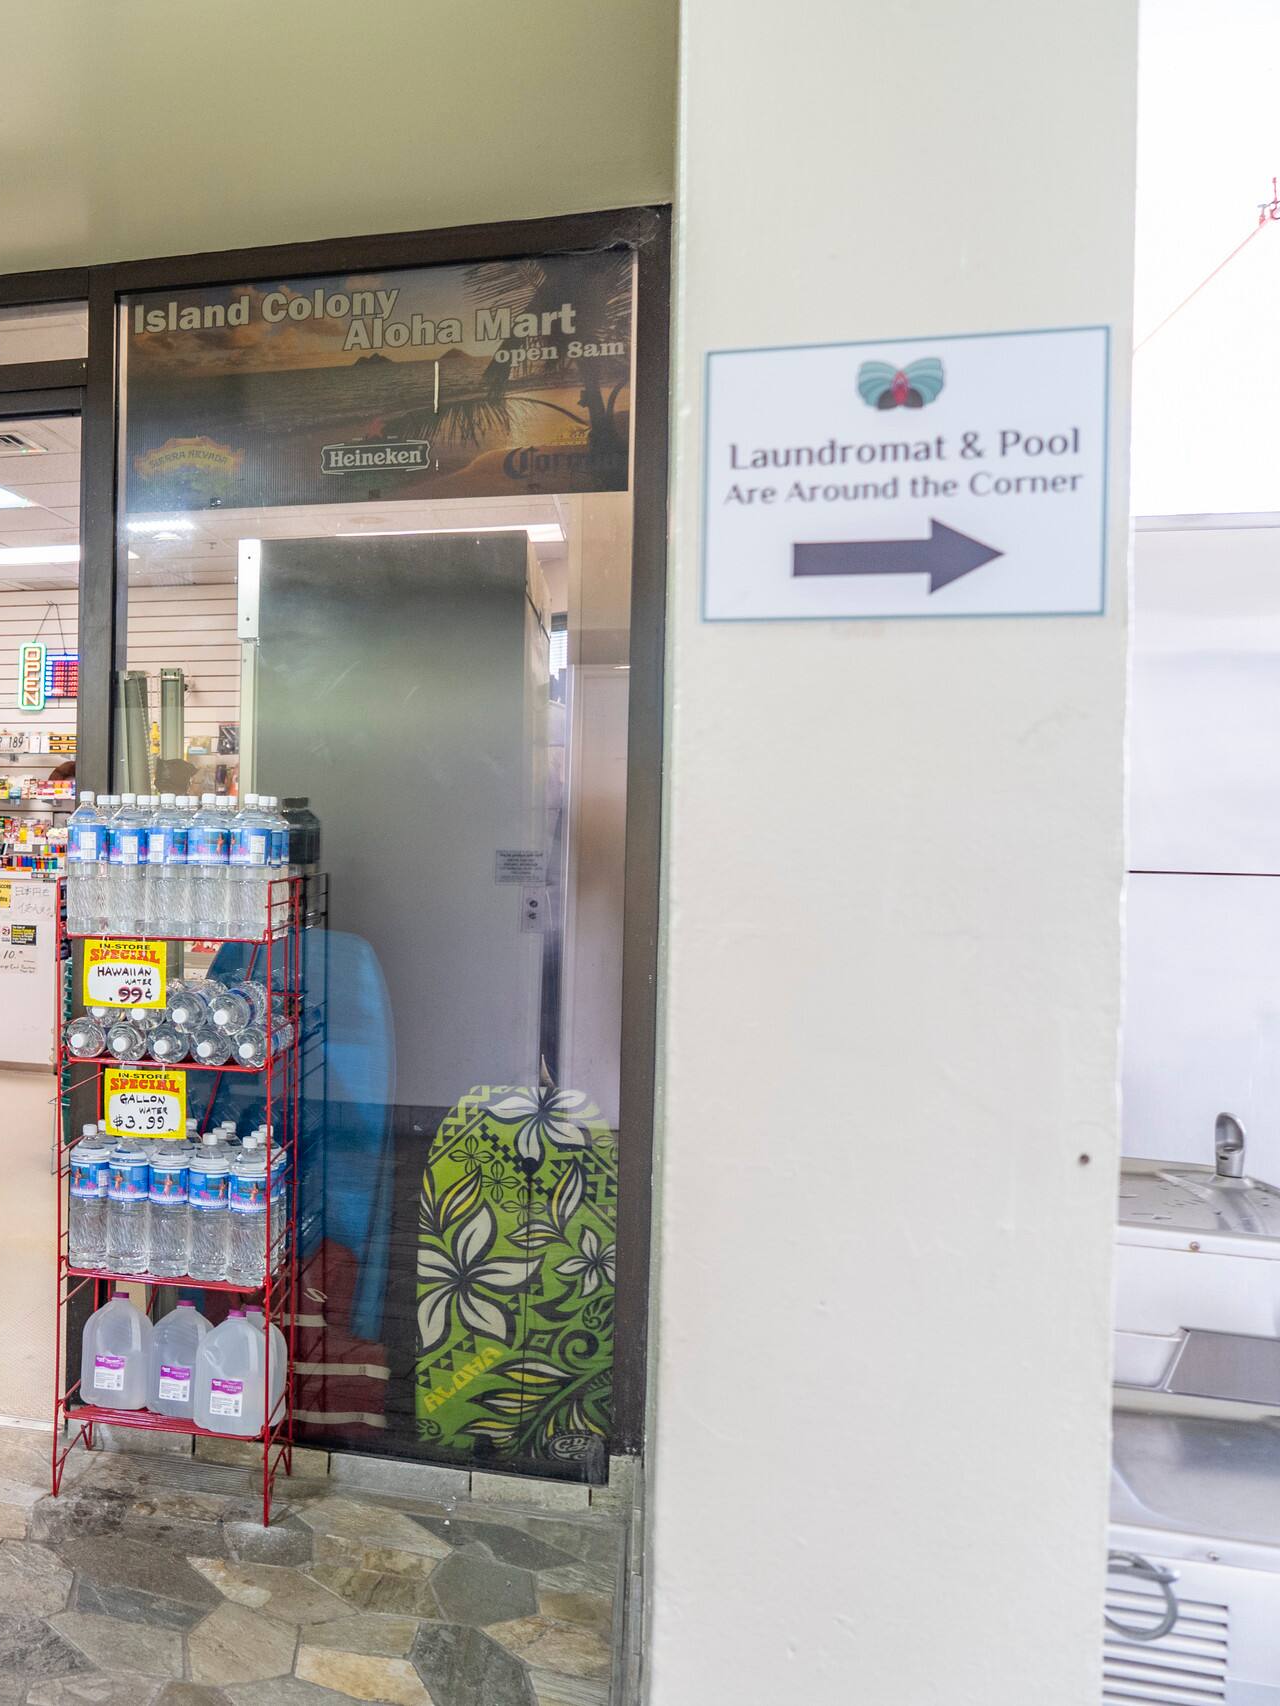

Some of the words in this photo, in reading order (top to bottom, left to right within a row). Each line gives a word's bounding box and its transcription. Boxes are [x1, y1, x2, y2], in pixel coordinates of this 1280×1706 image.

[134, 296, 250, 336] Island
[261, 288, 400, 323] Colony
[342, 316, 462, 351] Aloha
[475, 303, 577, 342] Mart
[495, 346, 559, 367] open
[567, 341, 625, 358] 8am
[329, 448, 422, 467] Heineken
[728, 434, 947, 471] Laundromat
[959, 430, 985, 460] &
[999, 427, 1081, 458] Pool
[723, 483, 777, 506] Are
[785, 476, 899, 503] Around
[910, 475, 959, 499] the
[968, 470, 1083, 497] Corner
[23, 647, 40, 706] OPEN
[90, 948, 160, 964] SPECIAL
[97, 966, 152, 977] HAWAIIAN
[110, 1078, 180, 1093] SPECIAL
[120, 1094, 165, 1104] GALLON
[139, 1107, 168, 1115] WATER
[112, 1114, 165, 1132] $3.99
[424, 1346, 504, 1413] ALOHA
